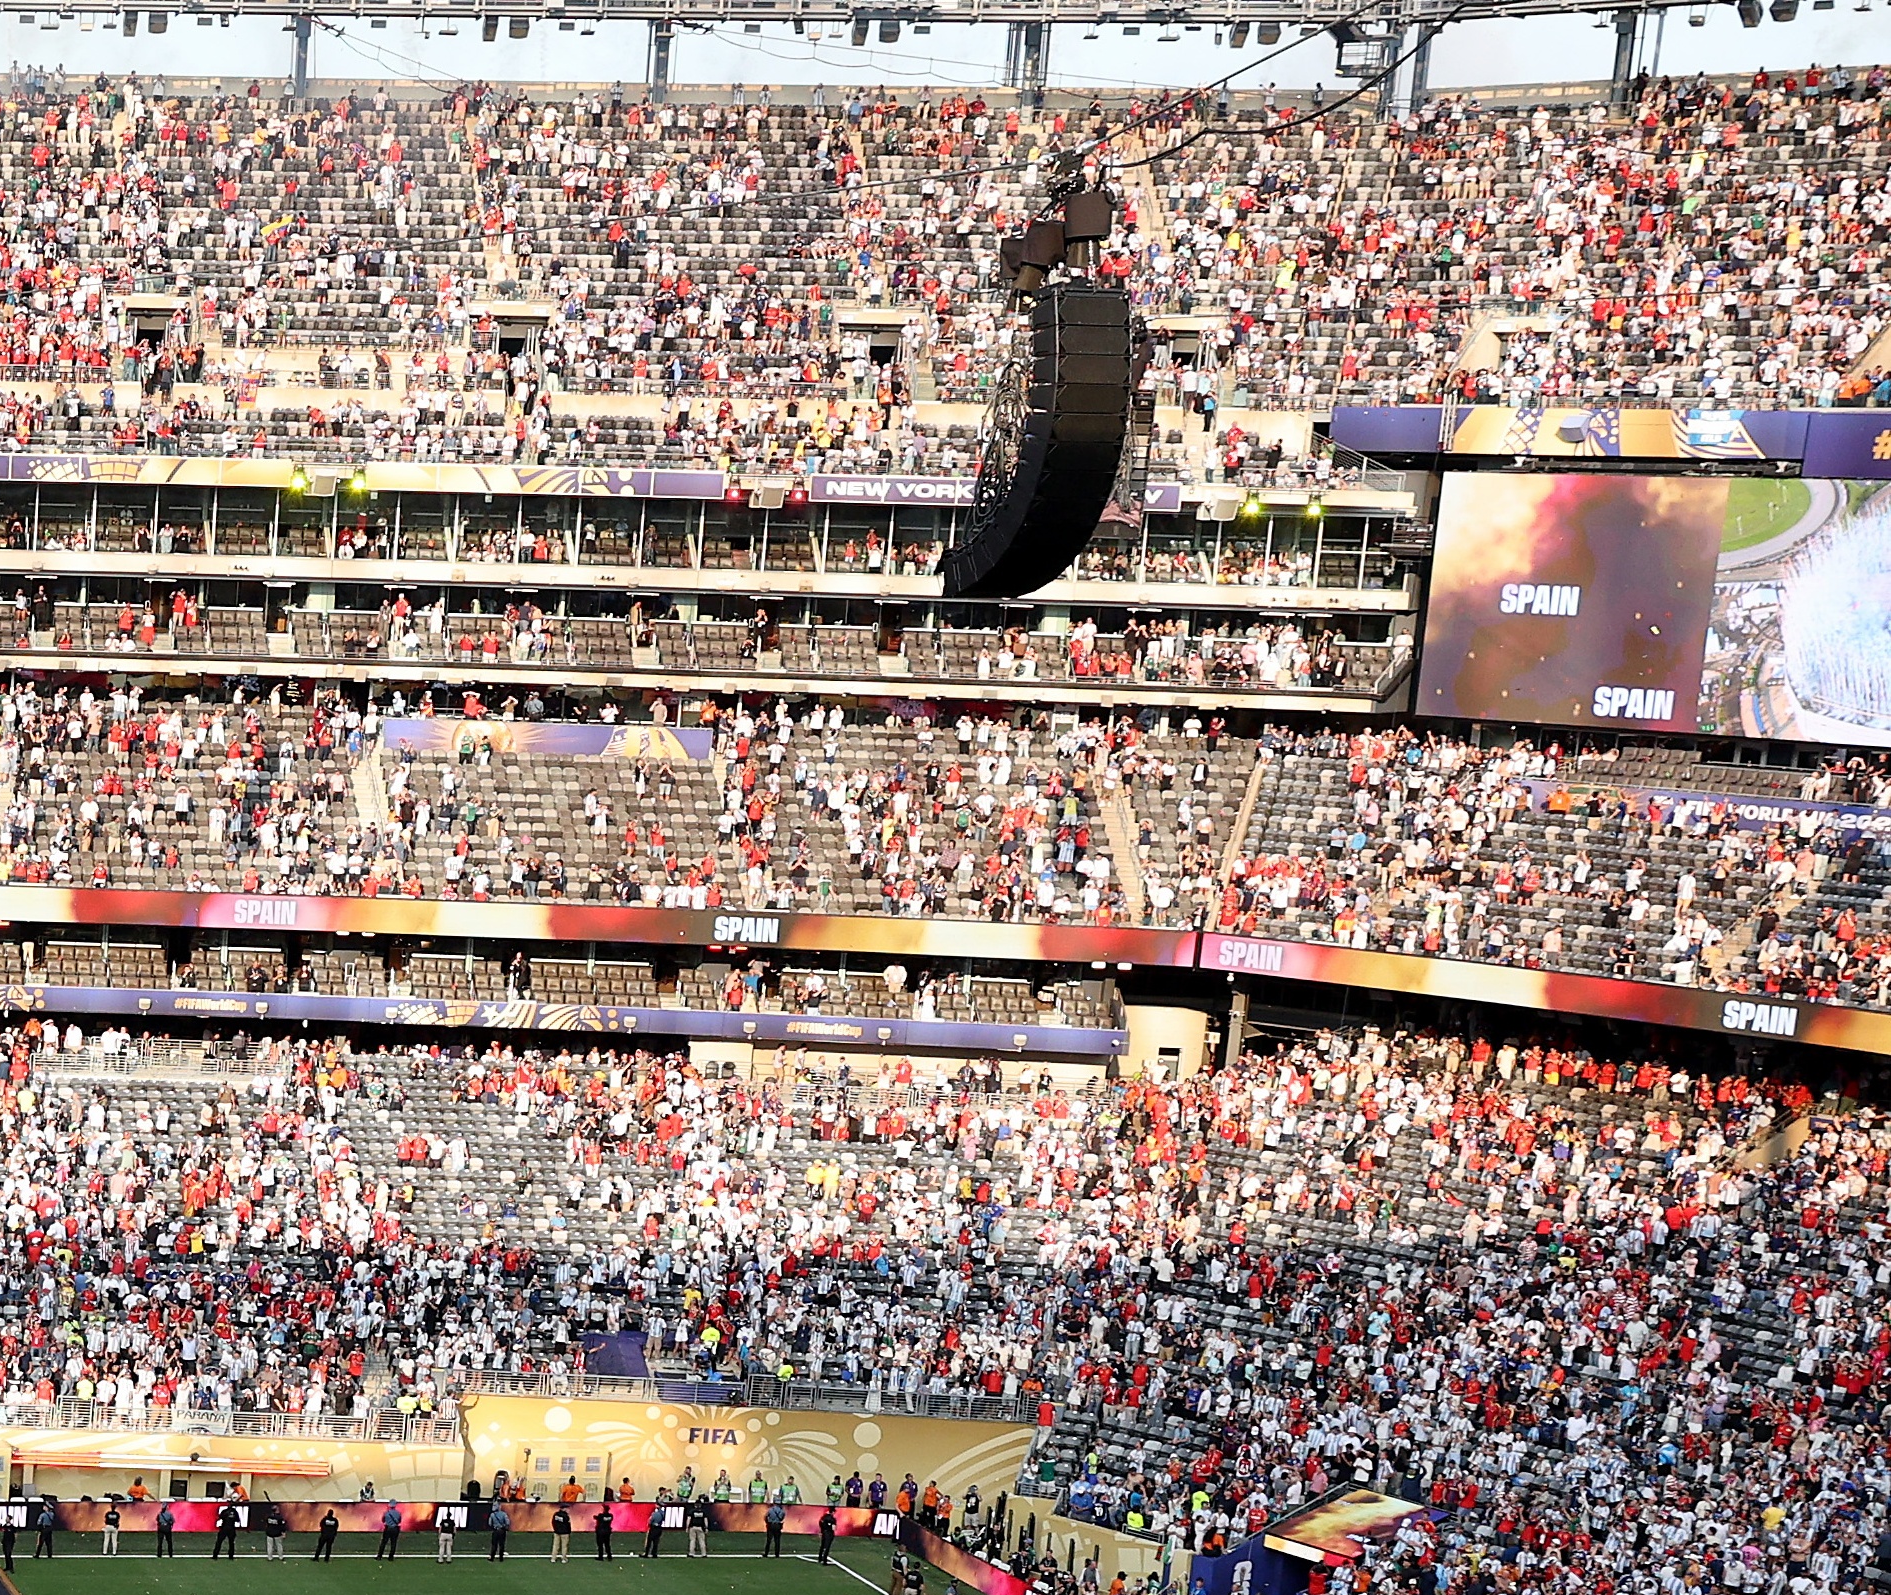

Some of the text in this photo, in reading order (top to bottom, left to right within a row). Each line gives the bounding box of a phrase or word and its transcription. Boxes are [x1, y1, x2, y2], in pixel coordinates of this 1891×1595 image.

[826, 481, 976, 502] NEW YORK
[1501, 584, 1579, 616] SPAIN
[1594, 686, 1675, 721] SPAIN
[234, 900, 297, 926] SPAIN
[714, 916, 780, 943] SPAIN
[1219, 940, 1283, 972] SPAIN
[175, 998, 247, 1013] #FIFAWorldCup
[1723, 1000, 1799, 1035] SPAIN
[787, 1022, 863, 1038] #FIFAWorldCup
[689, 1428, 737, 1445] FIFA
